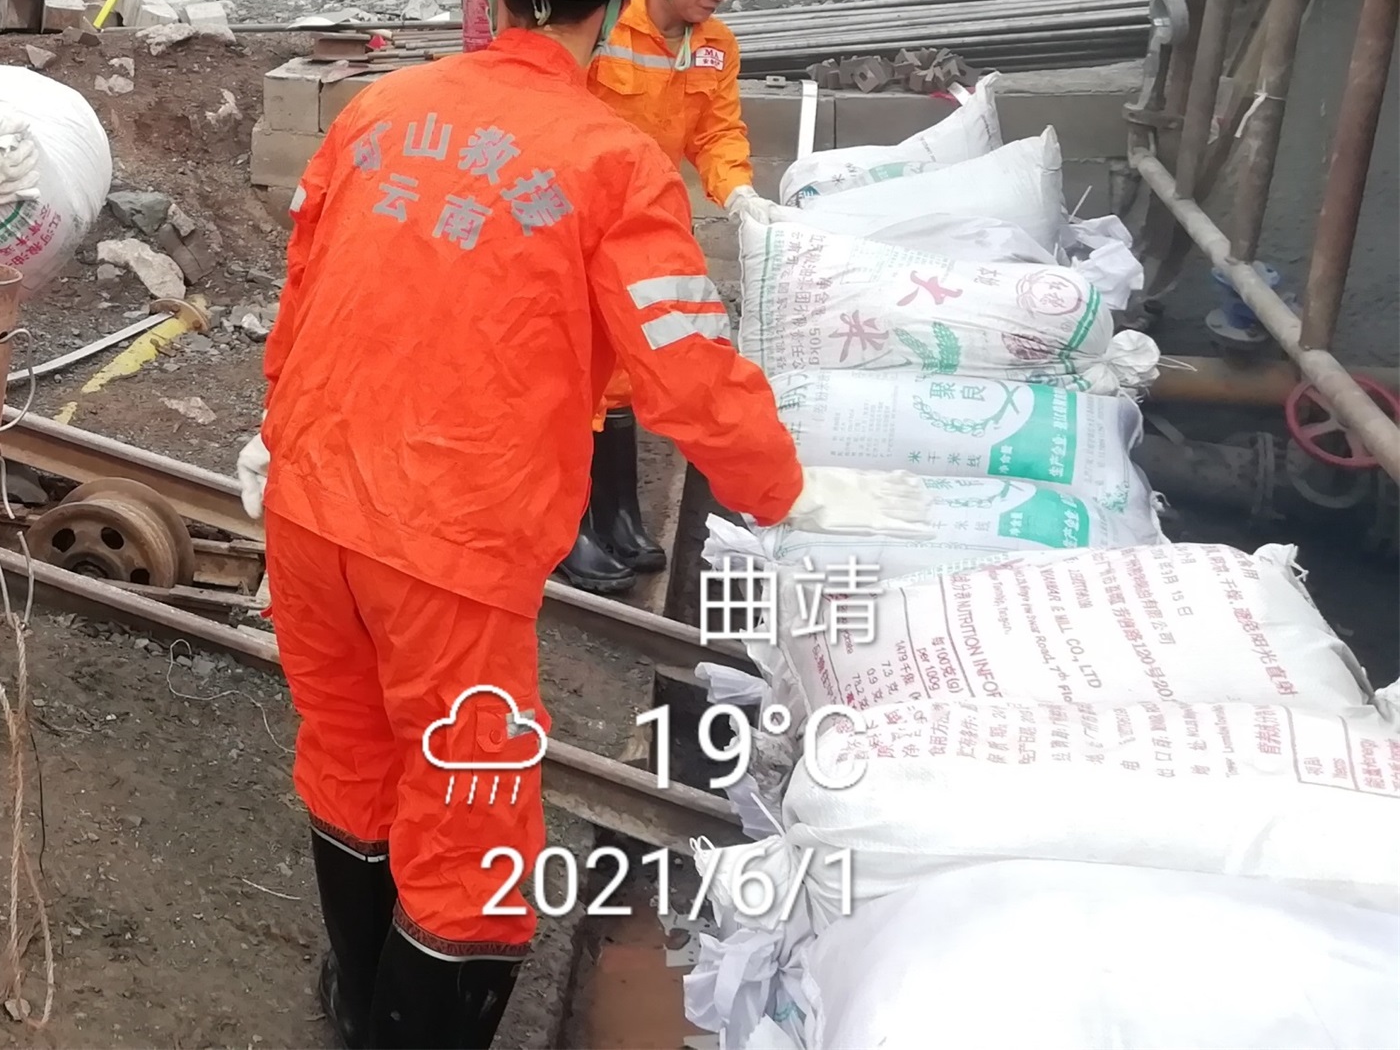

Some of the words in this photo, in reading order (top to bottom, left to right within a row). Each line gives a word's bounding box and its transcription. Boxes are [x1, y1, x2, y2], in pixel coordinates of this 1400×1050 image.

[372, 173, 494, 250] 云南
[808, 328, 822, 366] 50kg
[929, 382, 986, 402] 聚良
[917, 647, 932, 663] per
[925, 667, 941, 692] 100g
[1035, 635, 1051, 664] Road,
[1050, 665, 1067, 682] 7th
[1078, 663, 1102, 689] LTD
